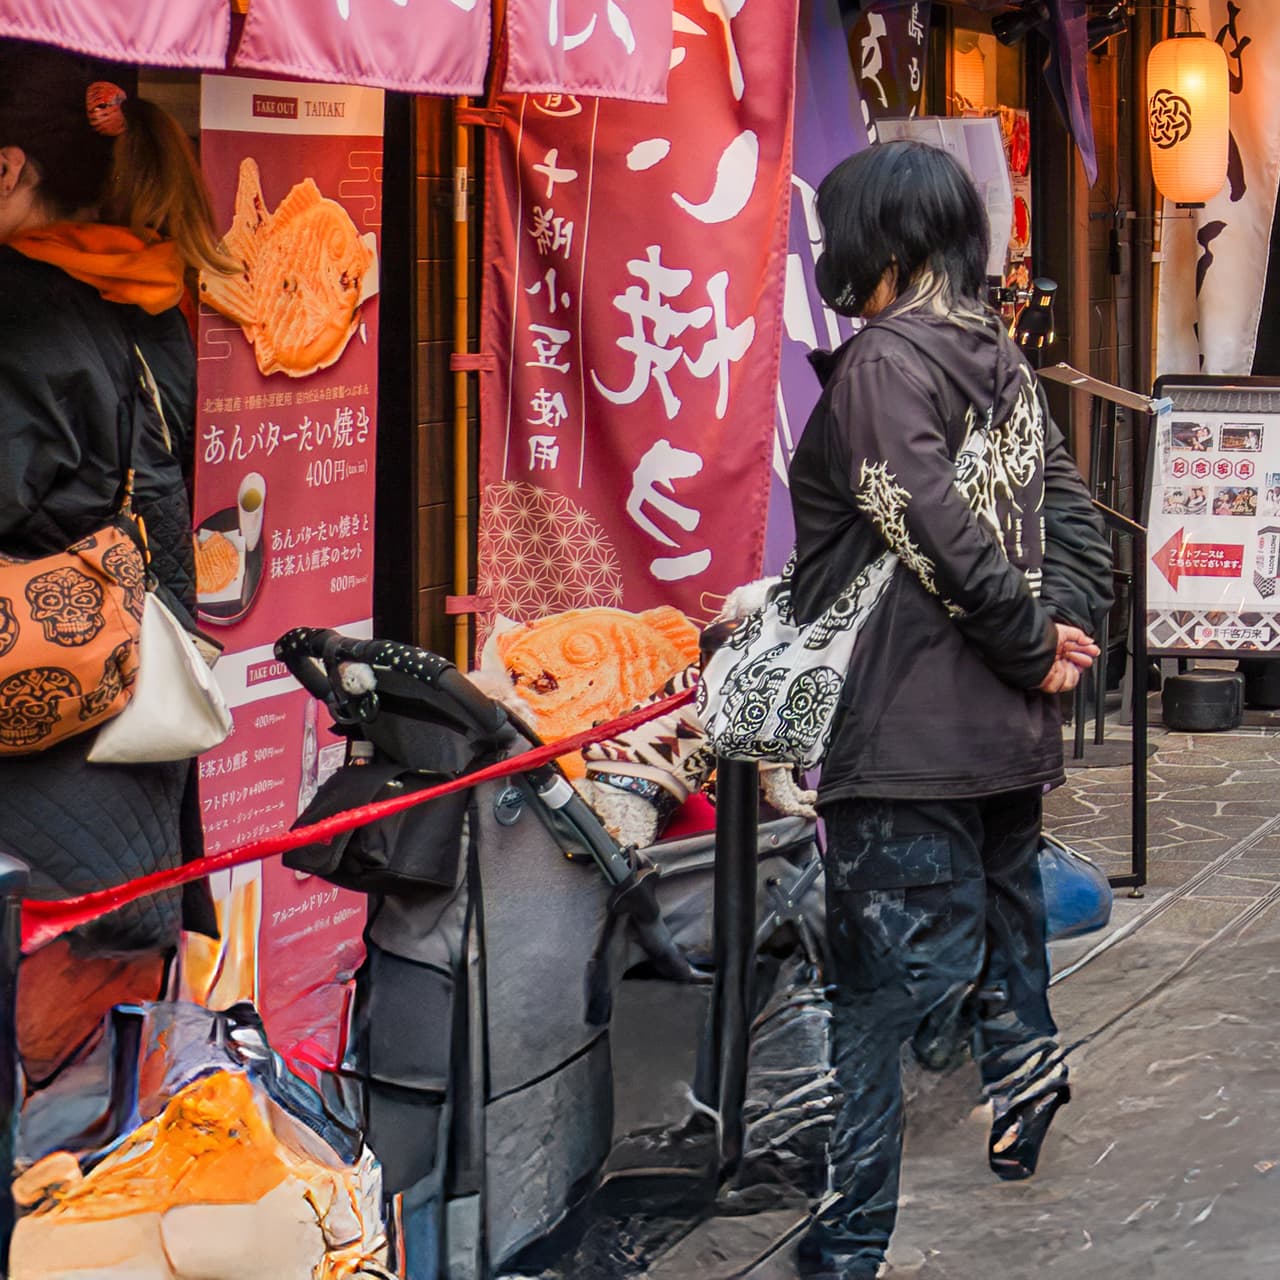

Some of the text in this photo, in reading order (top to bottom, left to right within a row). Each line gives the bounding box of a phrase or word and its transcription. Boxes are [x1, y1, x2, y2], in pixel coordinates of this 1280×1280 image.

[256, 100, 345, 117] TAKE OUT TAIYAKI
[203, 406, 370, 464] あんバターたい焼き
[271, 513, 369, 551] あんバターたい焼きと
[271, 543, 363, 579] 抹茶入り煎茶のセット
[1168, 558, 1242, 569] こちらでございます。
[249, 666, 268, 683] TAKE
